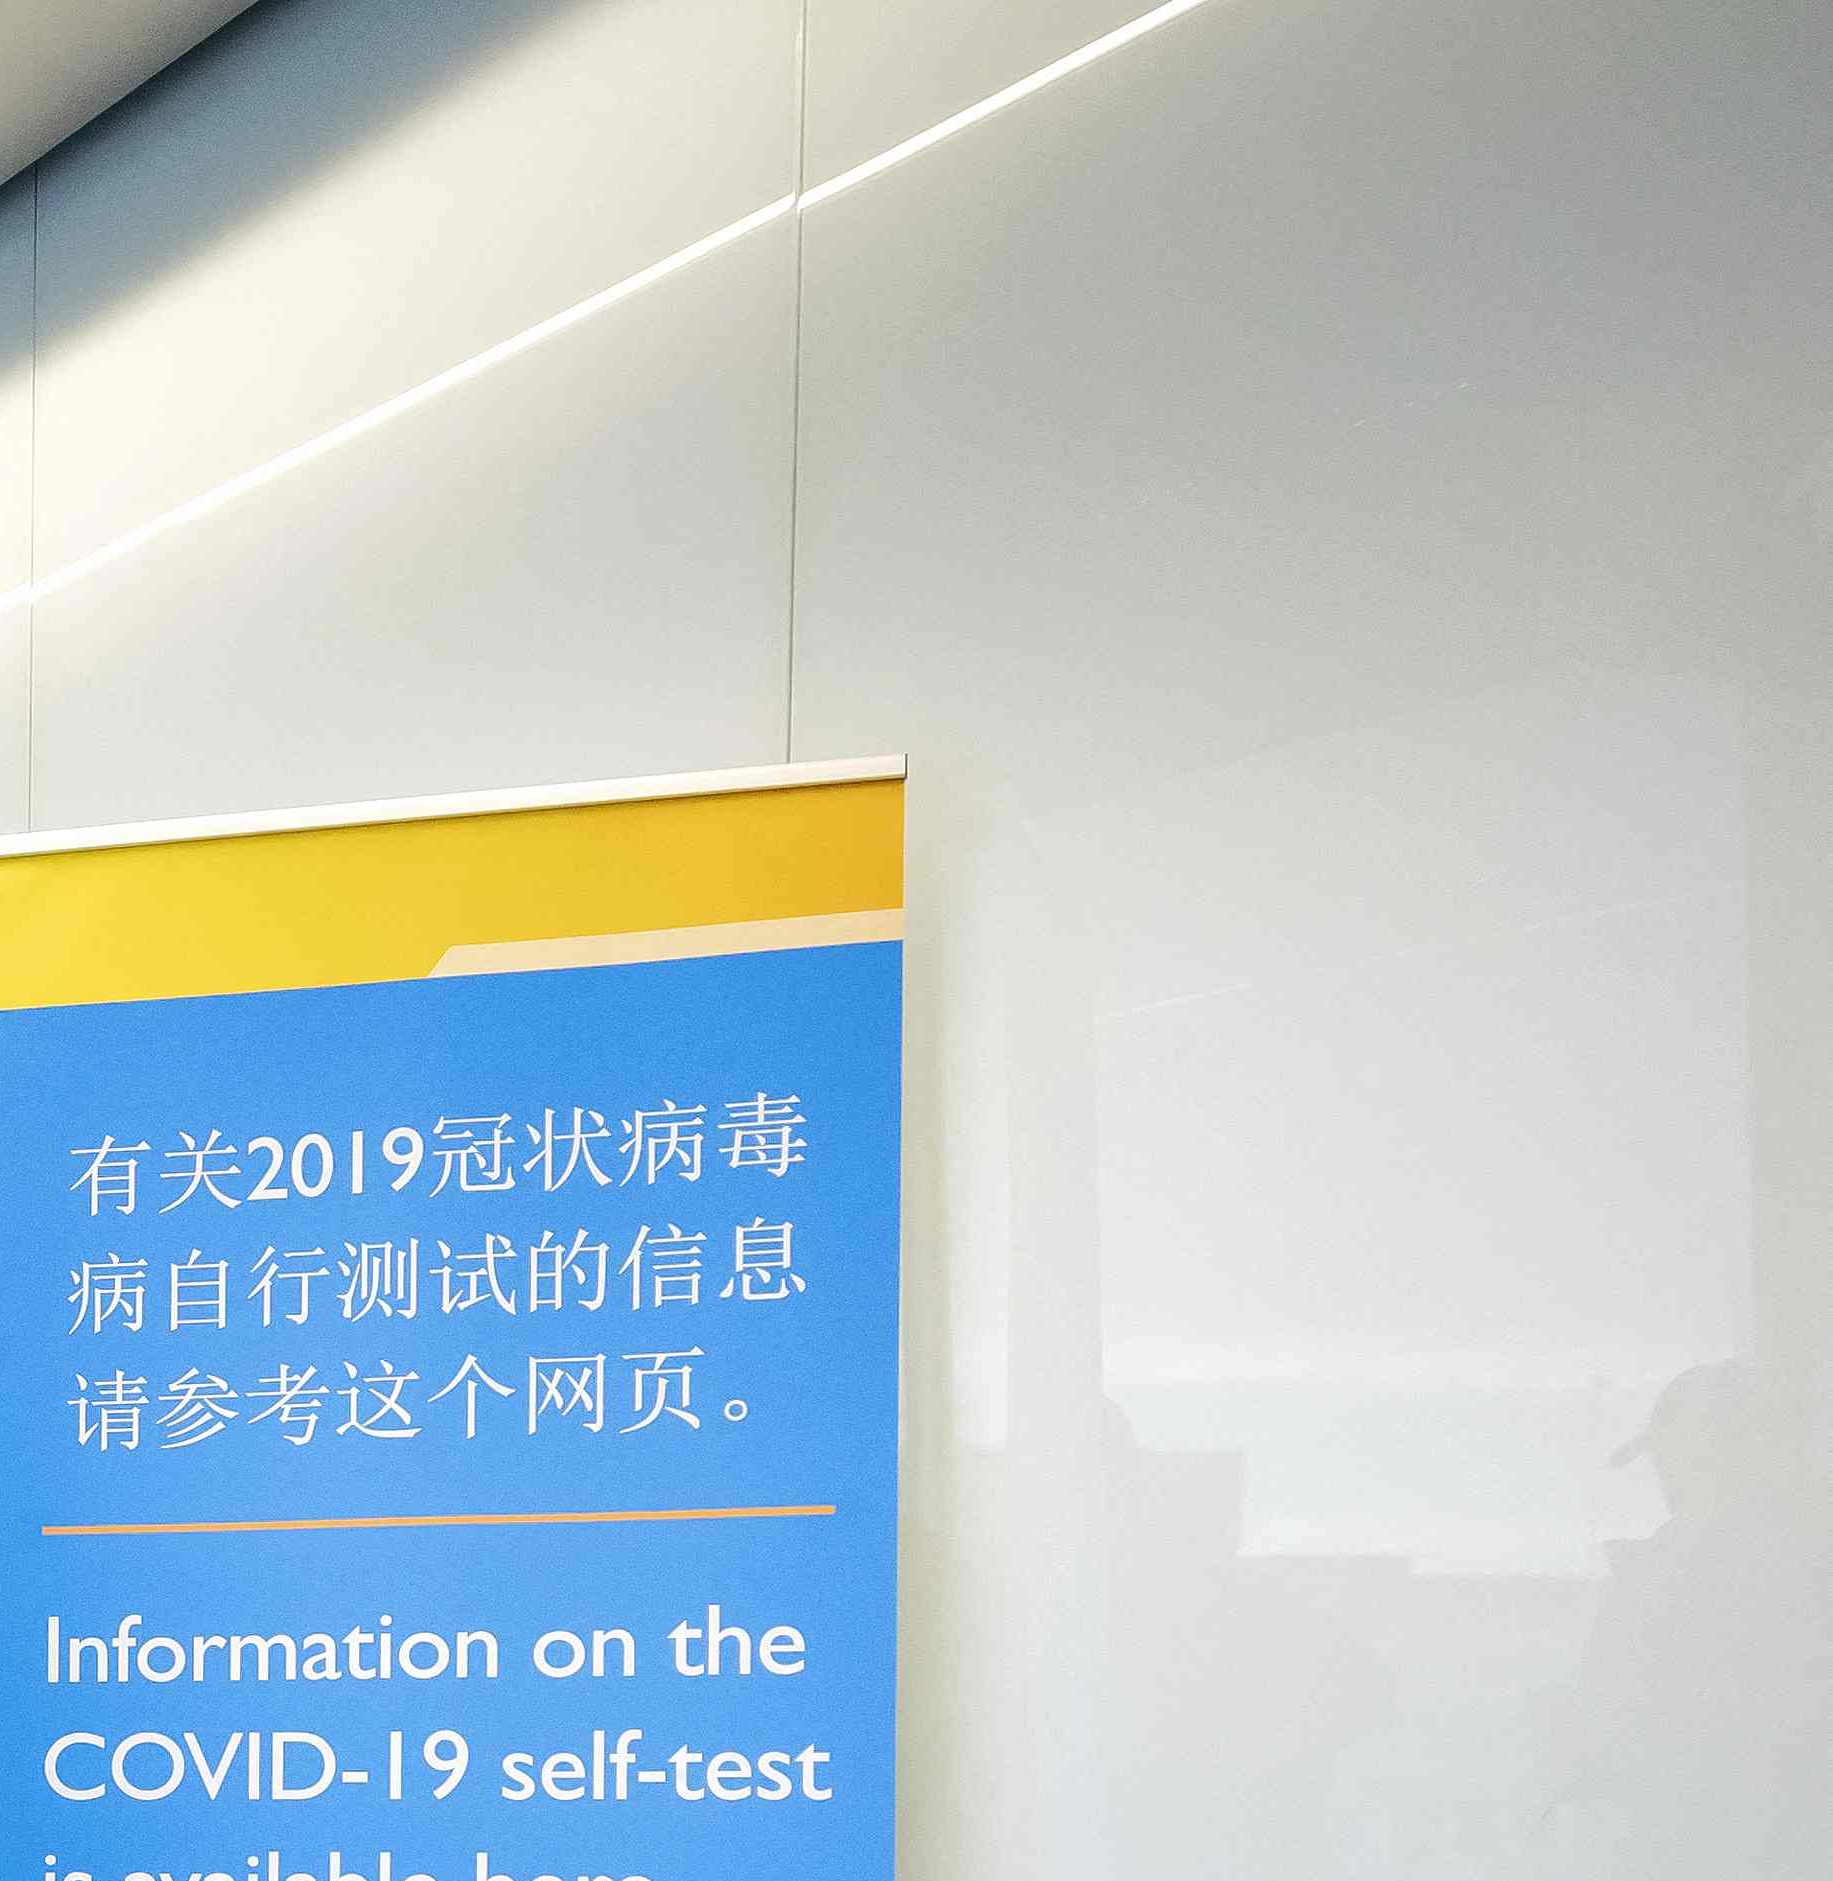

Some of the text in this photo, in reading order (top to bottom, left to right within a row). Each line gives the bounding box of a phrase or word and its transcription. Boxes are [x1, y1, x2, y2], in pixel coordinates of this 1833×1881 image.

[68, 1090, 809, 1218] 有关2019冠状病毒
[66, 1215, 808, 1336] 病自行测试的信息
[66, 1344, 751, 1452] 请参考这个网页。
[46, 1603, 807, 1684] Information on the
[43, 1727, 834, 1802] COVID-19 self-test
